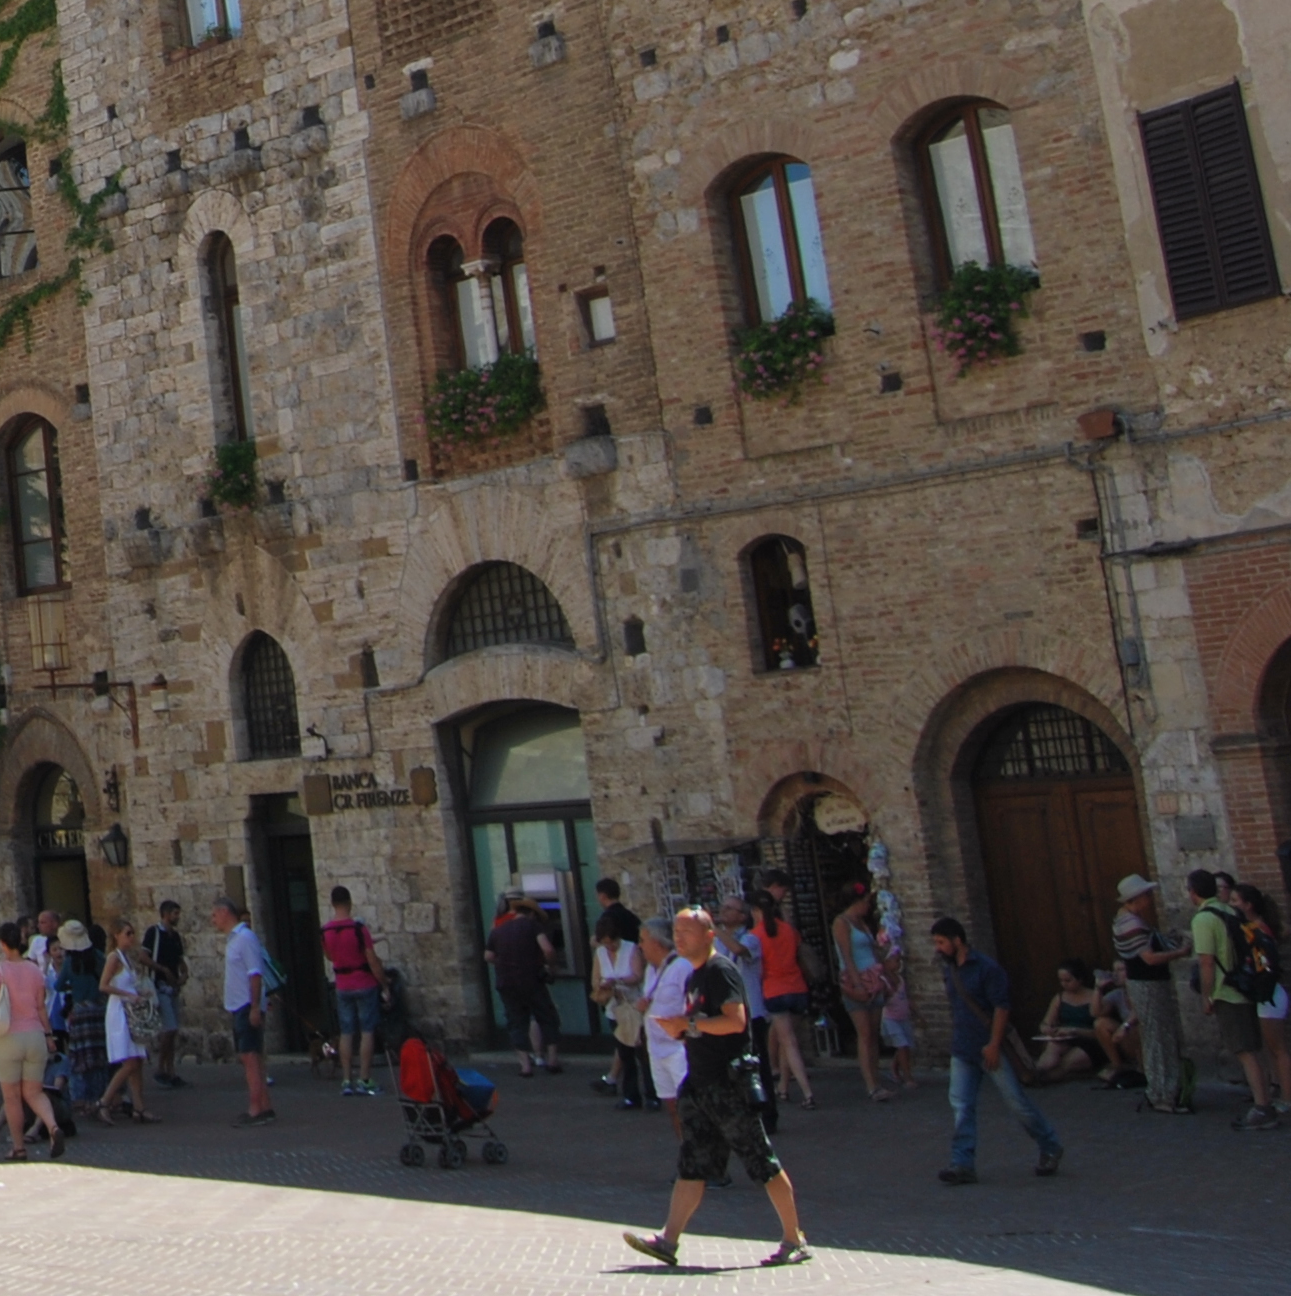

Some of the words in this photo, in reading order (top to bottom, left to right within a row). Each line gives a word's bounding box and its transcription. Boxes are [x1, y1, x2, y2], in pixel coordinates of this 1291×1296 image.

[332, 772, 378, 790] BANCA
[334, 793, 353, 810] CR
[356, 788, 411, 809] FIRENZE
